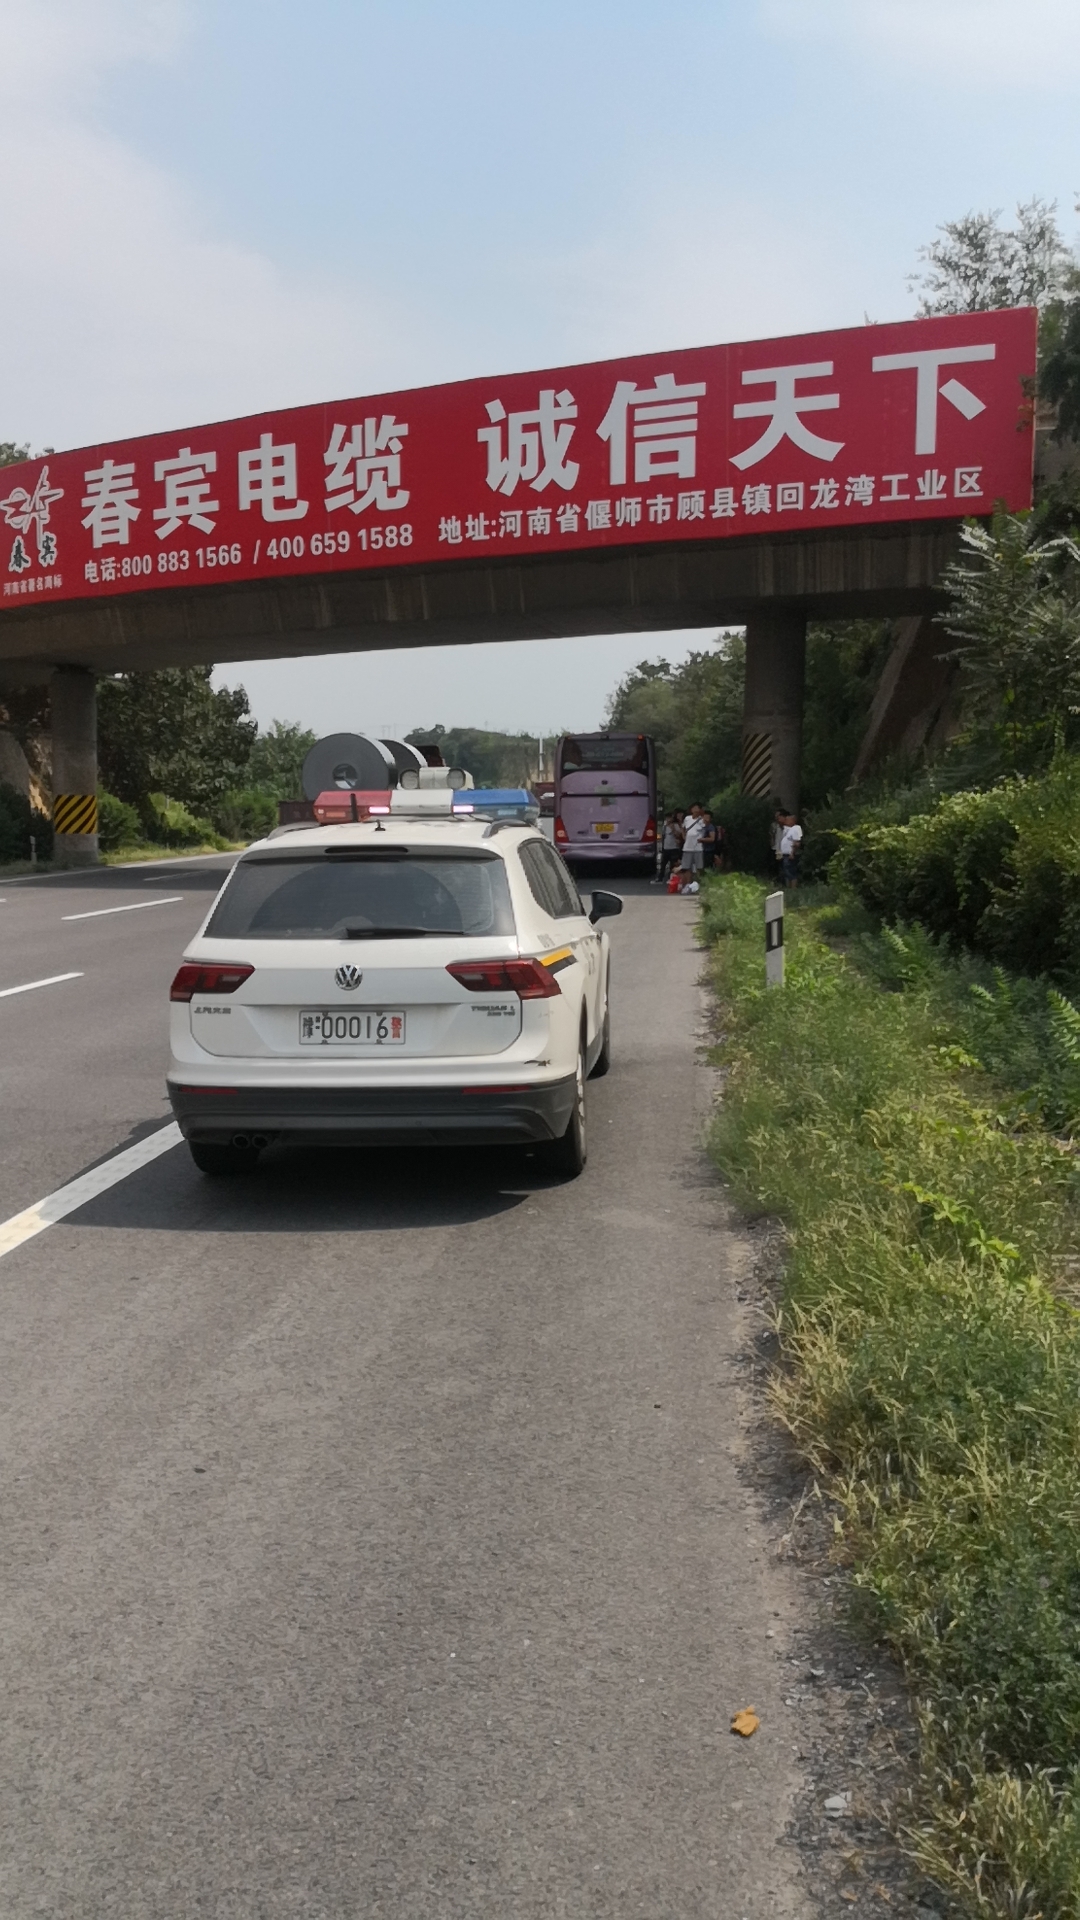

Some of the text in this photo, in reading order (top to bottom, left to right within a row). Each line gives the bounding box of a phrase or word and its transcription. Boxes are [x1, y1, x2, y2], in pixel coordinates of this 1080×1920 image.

[80, 343, 997, 549] 春宾电缆 诚信天下
[438, 466, 984, 544] 地址:河南省偃师市顾县镇回龙湾工业区
[157, 549, 190, 573] 883
[196, 544, 242, 569] 1566
[310, 531, 351, 556] 659
[357, 524, 413, 551] 1588
